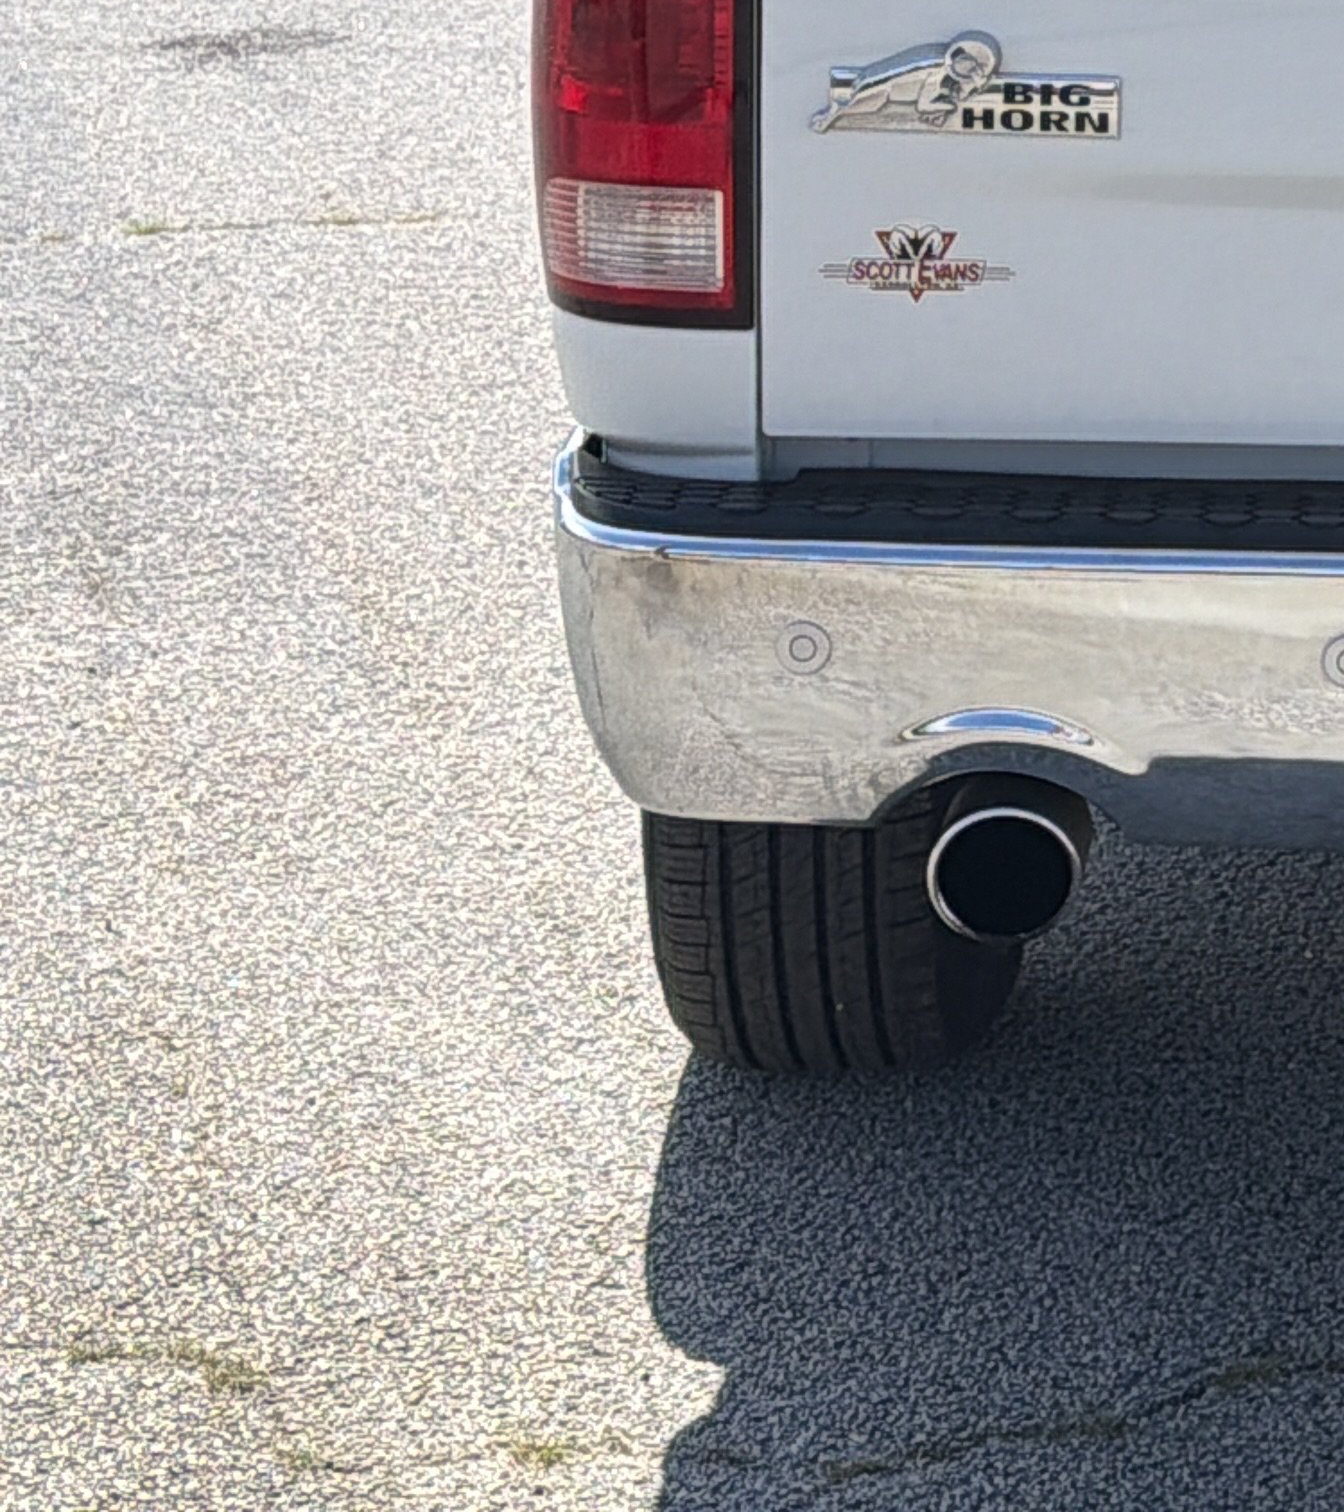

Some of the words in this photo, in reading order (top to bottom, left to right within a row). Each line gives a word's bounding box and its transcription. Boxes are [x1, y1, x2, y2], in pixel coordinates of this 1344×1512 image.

[1002, 82, 1091, 107] BIG
[962, 107, 1109, 133] HORN
[853, 261, 914, 281] SCOTT
